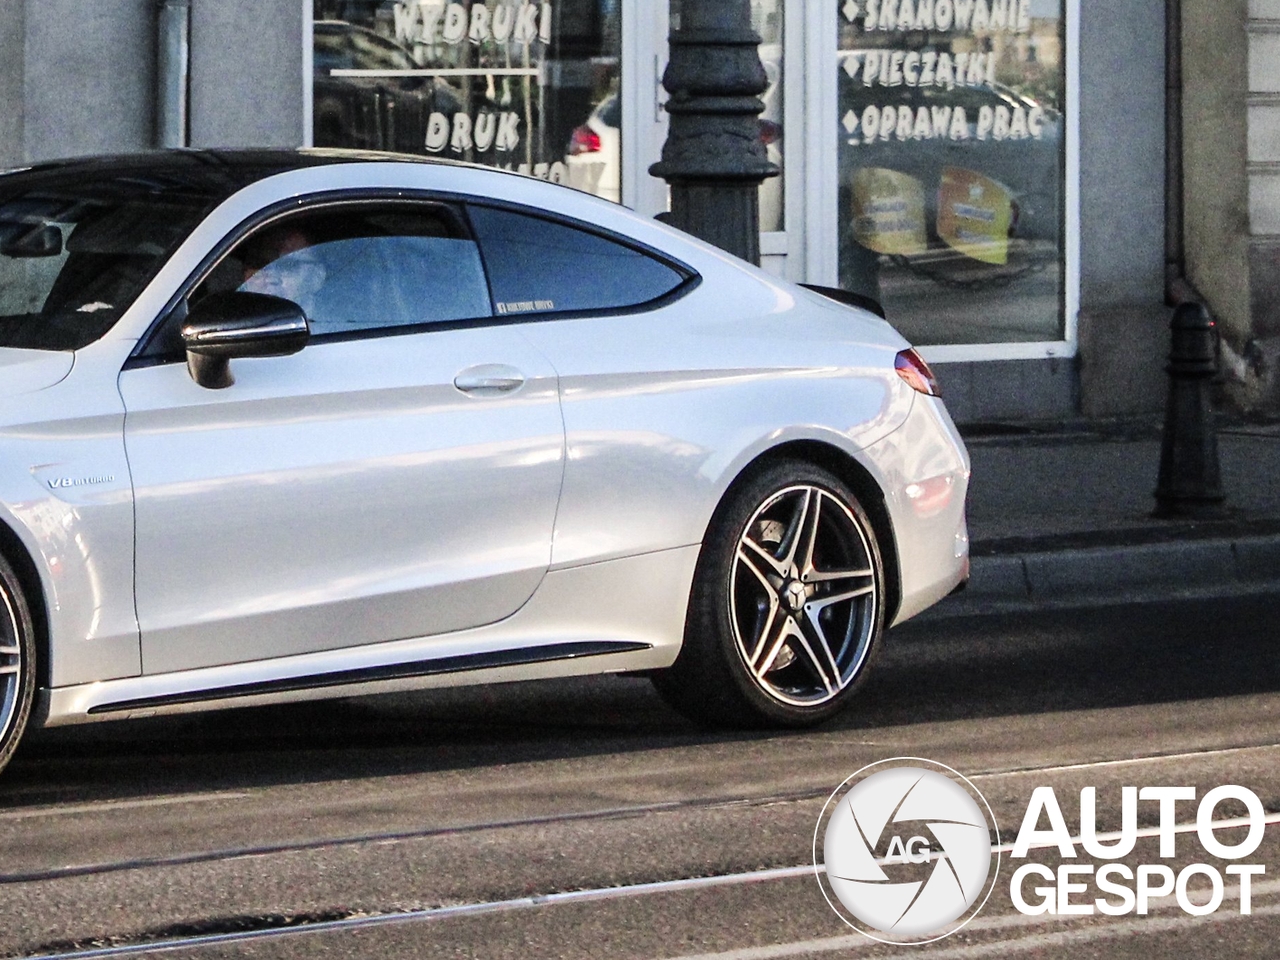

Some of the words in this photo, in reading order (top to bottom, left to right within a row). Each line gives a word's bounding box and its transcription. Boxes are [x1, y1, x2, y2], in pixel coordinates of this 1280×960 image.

[392, 2, 553, 46] WYDRUKI
[863, 50, 996, 92] PIECZĄTKI
[424, 111, 521, 154] DRUK
[861, 104, 970, 143] OPRAWA
[976, 104, 1044, 142] PRAC
[47, 477, 73, 489] V8
